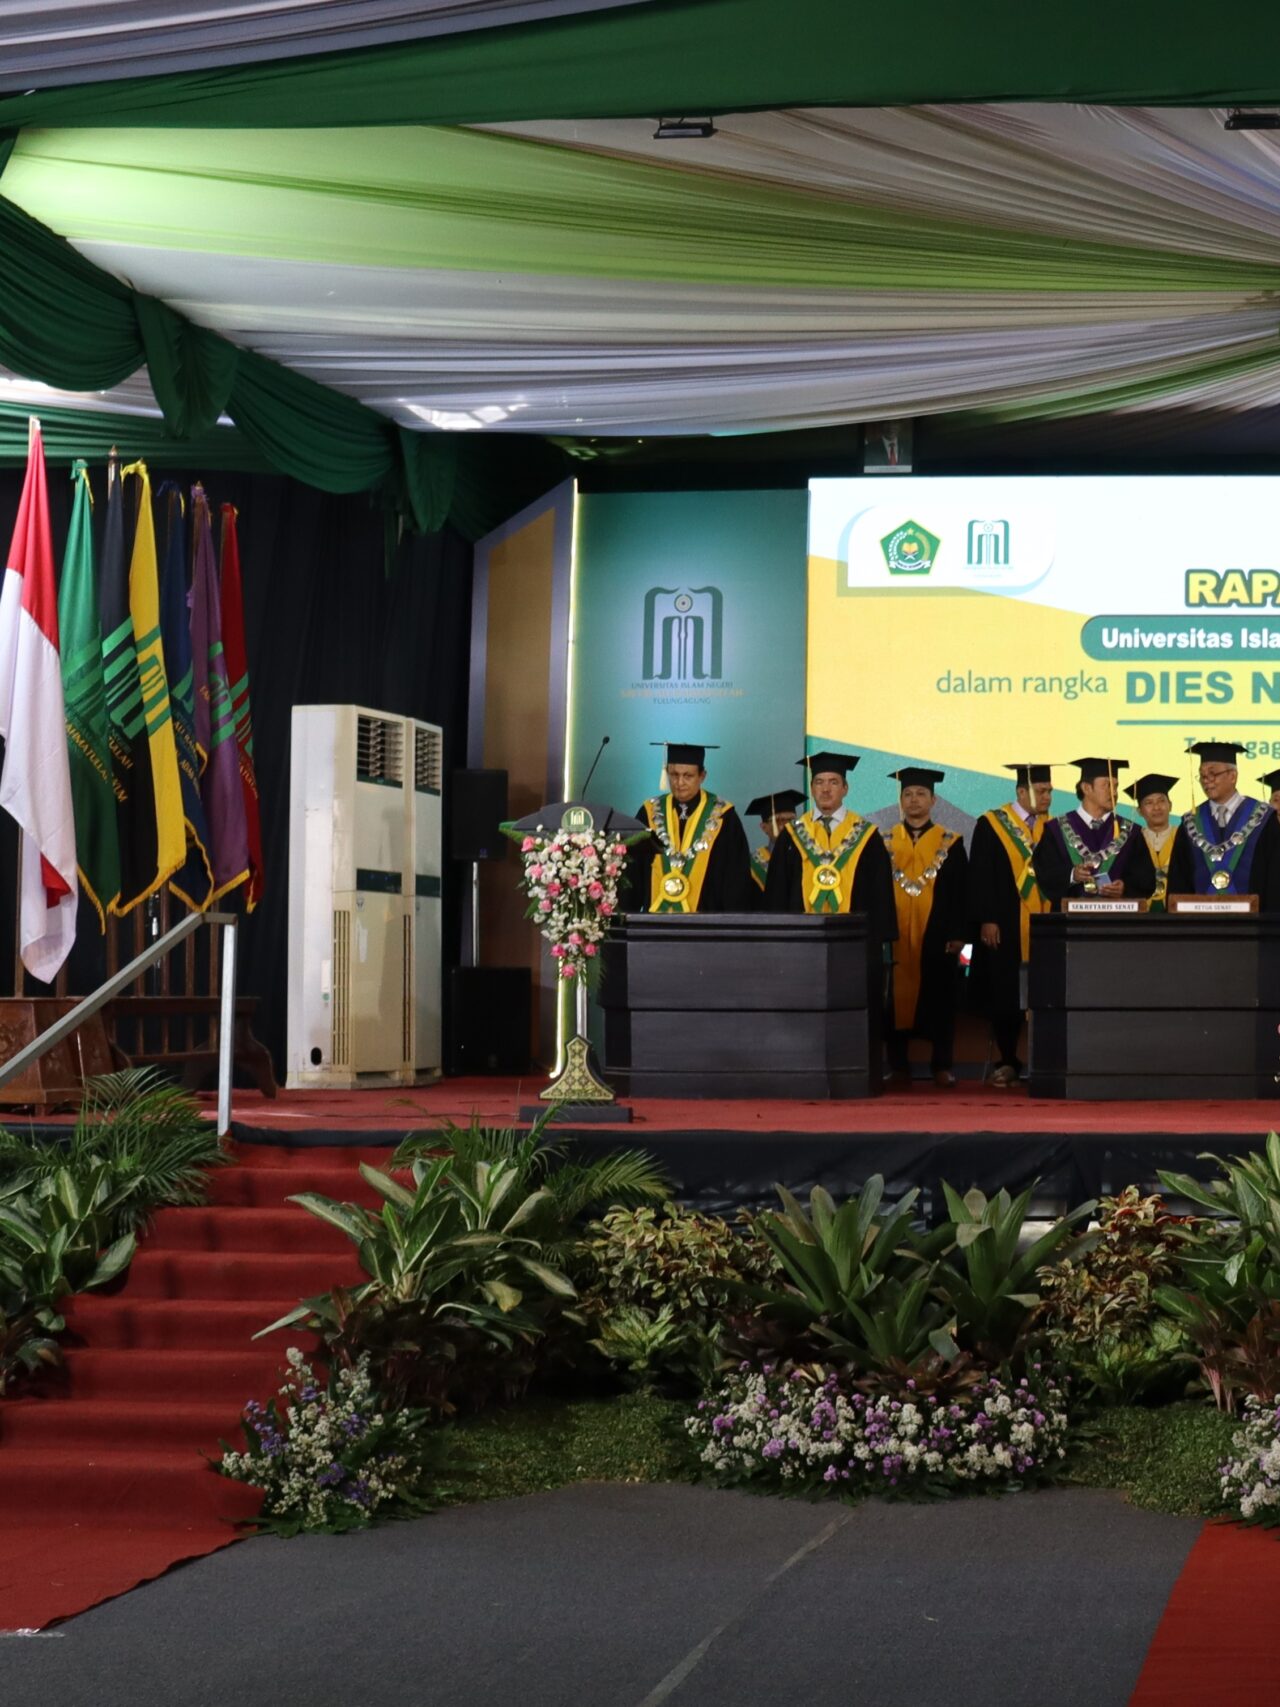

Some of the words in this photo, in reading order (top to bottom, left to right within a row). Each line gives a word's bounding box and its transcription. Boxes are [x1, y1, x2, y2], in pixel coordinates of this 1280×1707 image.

[1101, 627, 1233, 649] Universitas
[936, 670, 1012, 693] dalam
[1022, 670, 1108, 700] rangka
[1125, 671, 1234, 704] DIES
